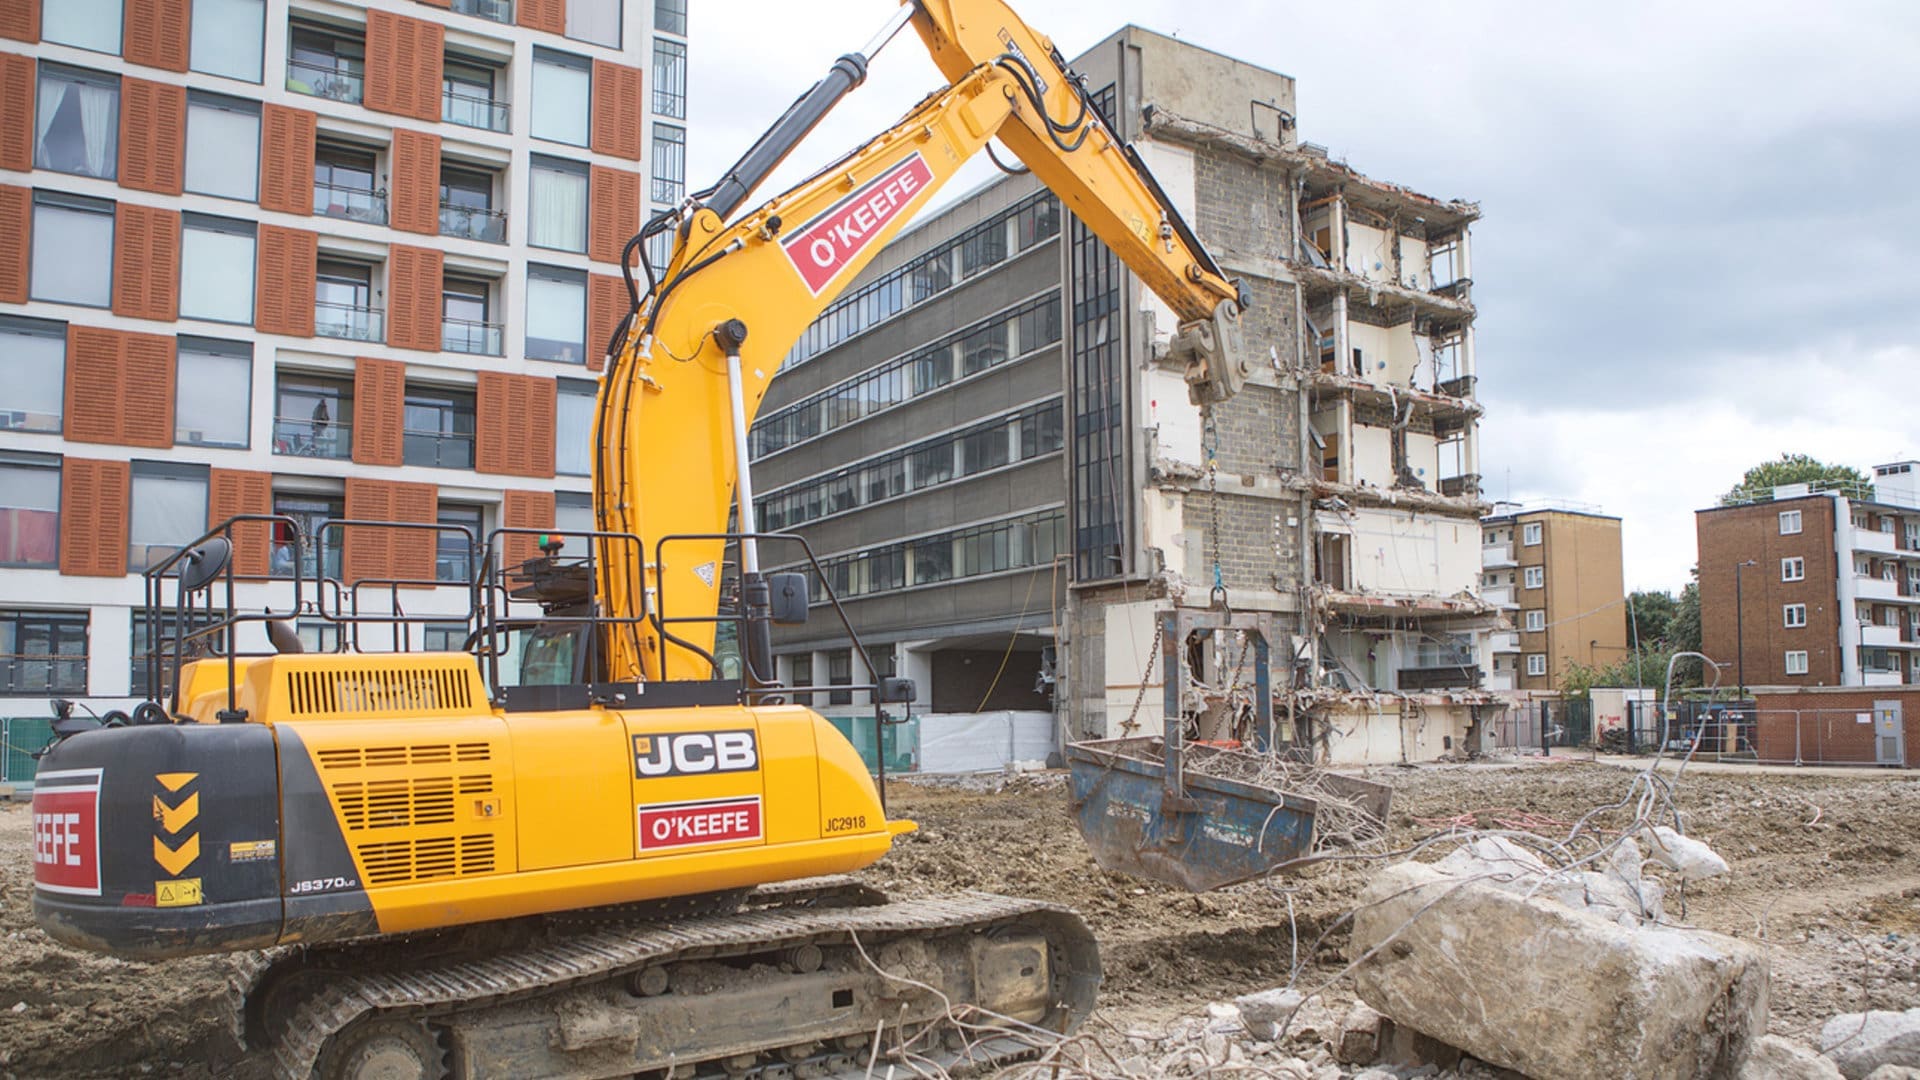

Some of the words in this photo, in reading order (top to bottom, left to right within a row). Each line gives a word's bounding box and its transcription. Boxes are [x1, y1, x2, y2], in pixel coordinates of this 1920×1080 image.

[810, 170, 918, 268] O'KEEFE
[637, 732, 756, 775] JCB
[33, 813, 80, 866] EEFE
[652, 811, 749, 840] O'KEEFE
[825, 815, 866, 832] JC2918
